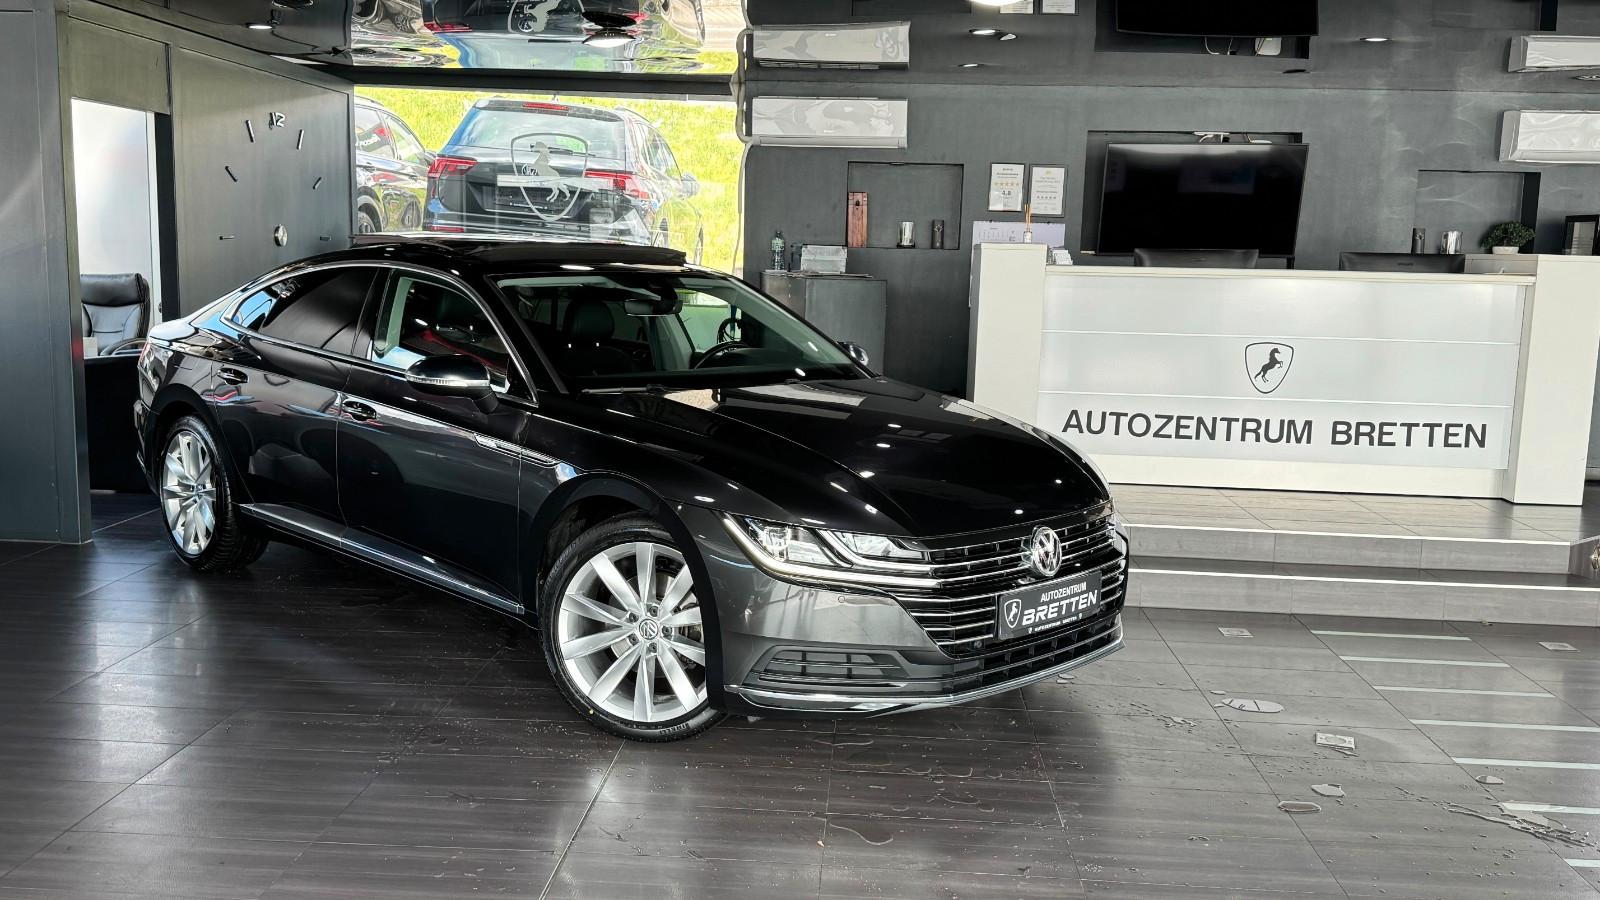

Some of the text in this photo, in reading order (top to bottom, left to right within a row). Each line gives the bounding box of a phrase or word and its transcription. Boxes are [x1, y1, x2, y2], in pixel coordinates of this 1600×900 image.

[270, 112, 286, 128] 12
[1062, 409, 1487, 449] AUTOZENTRUM BRETTEN
[1040, 581, 1087, 603] AUTOZENTRUM
[1022, 589, 1098, 626] BRETTEN
